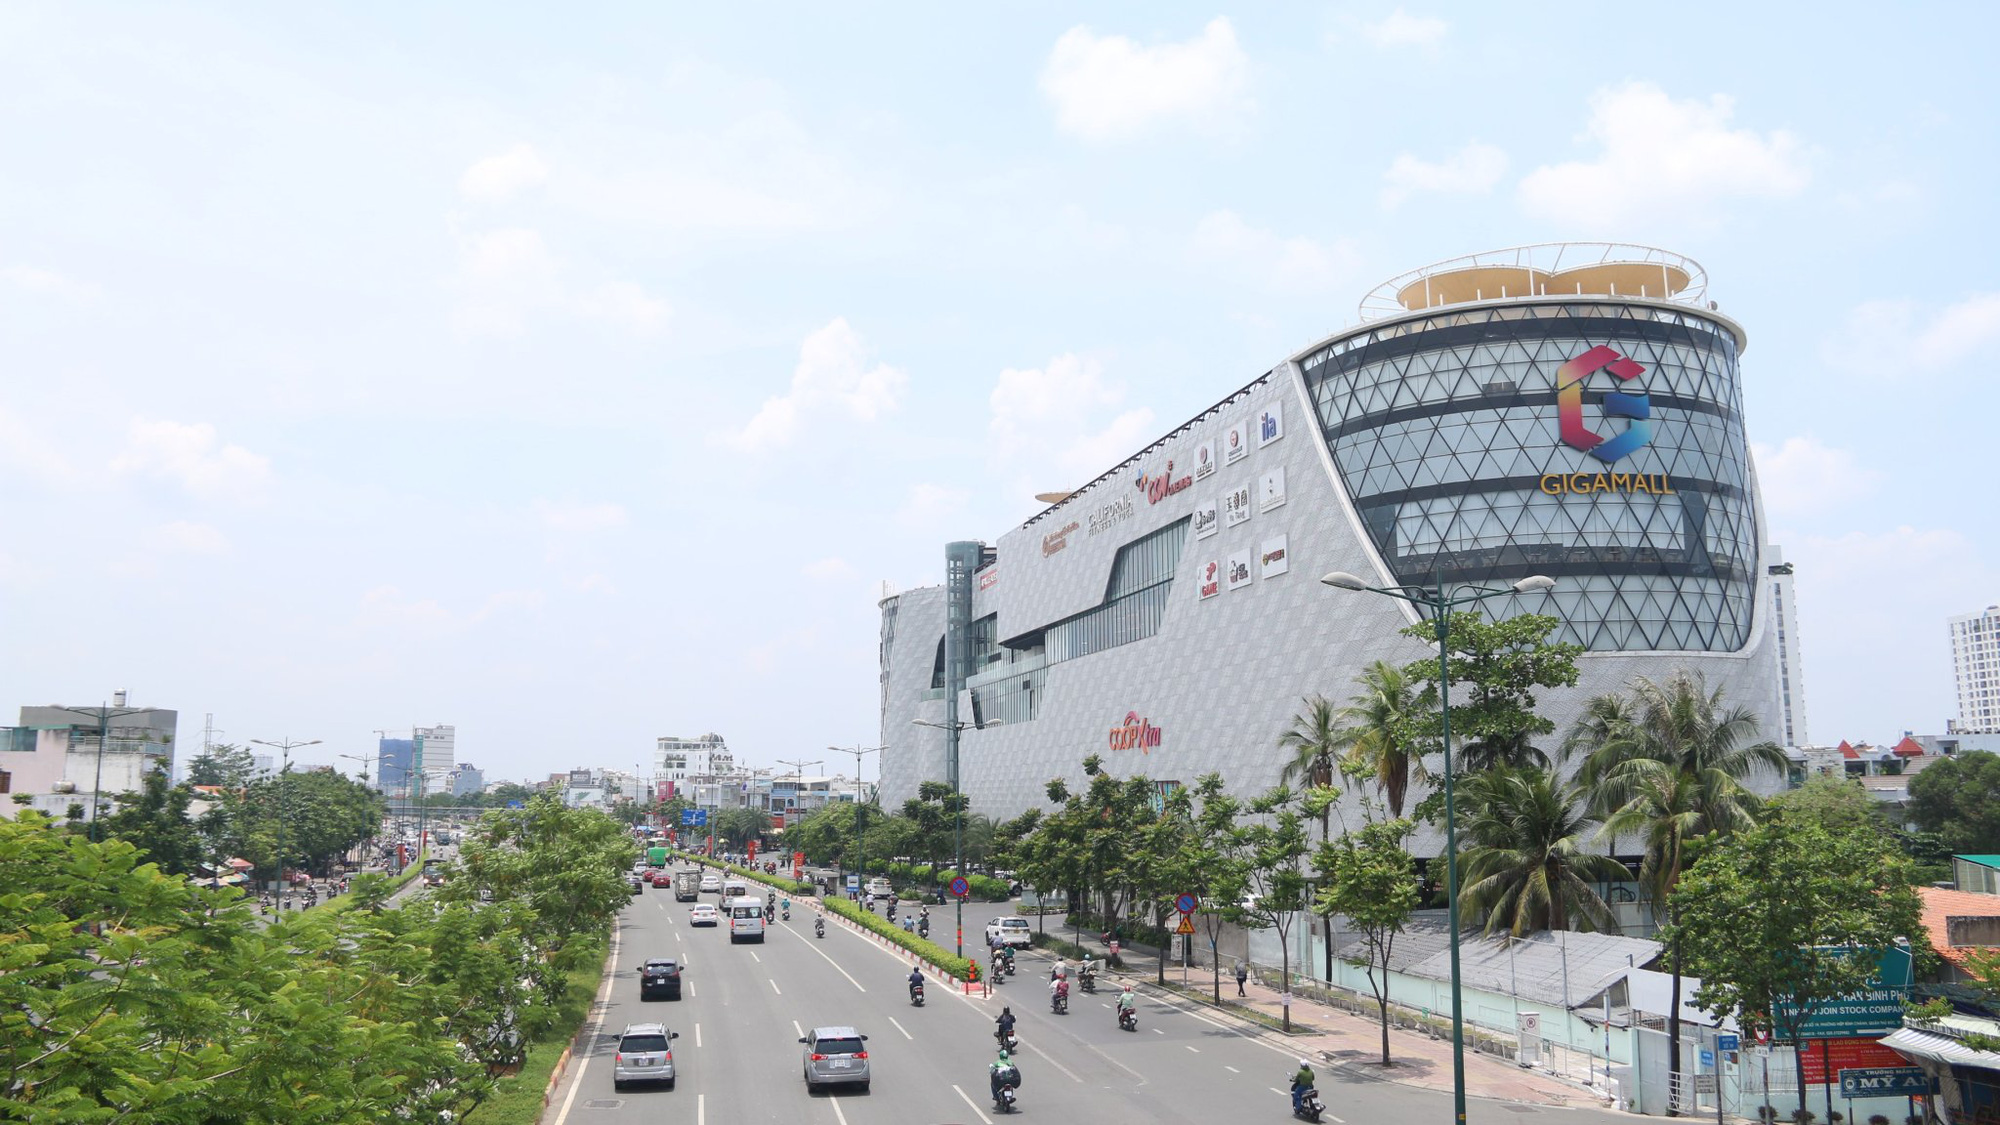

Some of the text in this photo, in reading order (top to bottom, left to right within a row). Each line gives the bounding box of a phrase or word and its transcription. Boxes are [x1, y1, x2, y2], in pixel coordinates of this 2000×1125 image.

[1261, 412, 1277, 441] ila
[1540, 473, 1676, 495] GIGAMALL
[1088, 492, 1133, 525] CALIFORNIA
[1088, 521, 1113, 537] FITNESS
[1118, 507, 1134, 522] YOGA
[1202, 582, 1218, 597] GAME
[1818, 1007, 1838, 1016] JOIN
[1839, 1006, 1868, 1015] STOCK
[1869, 1005, 1910, 1014] COMPANY
[1859, 1075, 1896, 1088] MỸ
